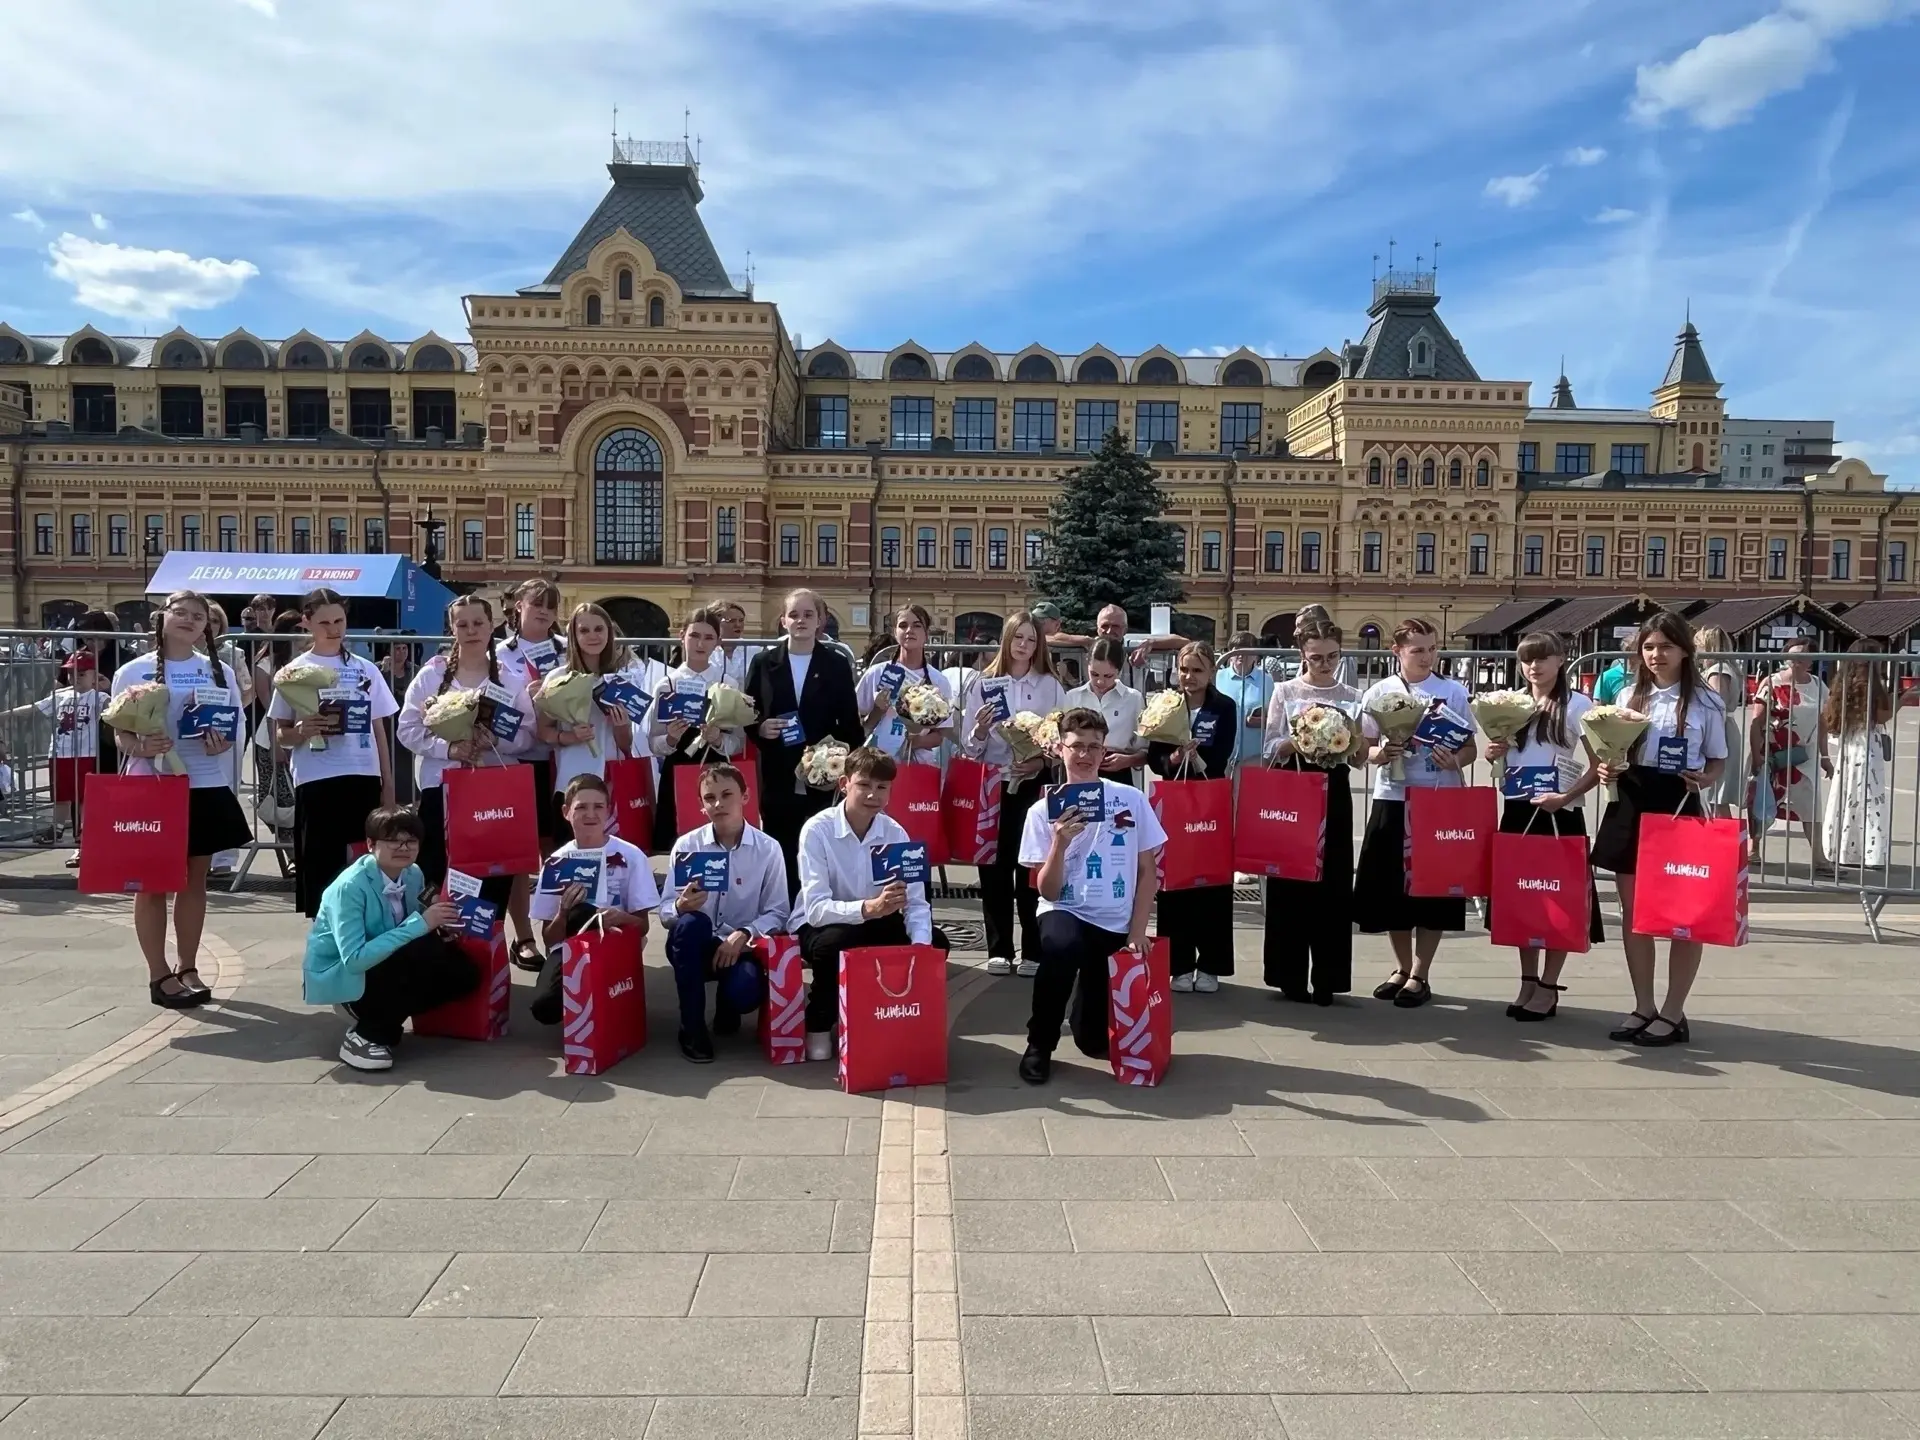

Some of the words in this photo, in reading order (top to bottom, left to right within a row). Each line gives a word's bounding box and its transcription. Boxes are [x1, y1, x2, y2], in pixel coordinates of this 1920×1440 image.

[189, 567, 233, 580] ДЕНЬ
[235, 567, 300, 580] РОССИИ
[308, 570, 321, 579] 12
[322, 570, 355, 579] ИЮНЯ
